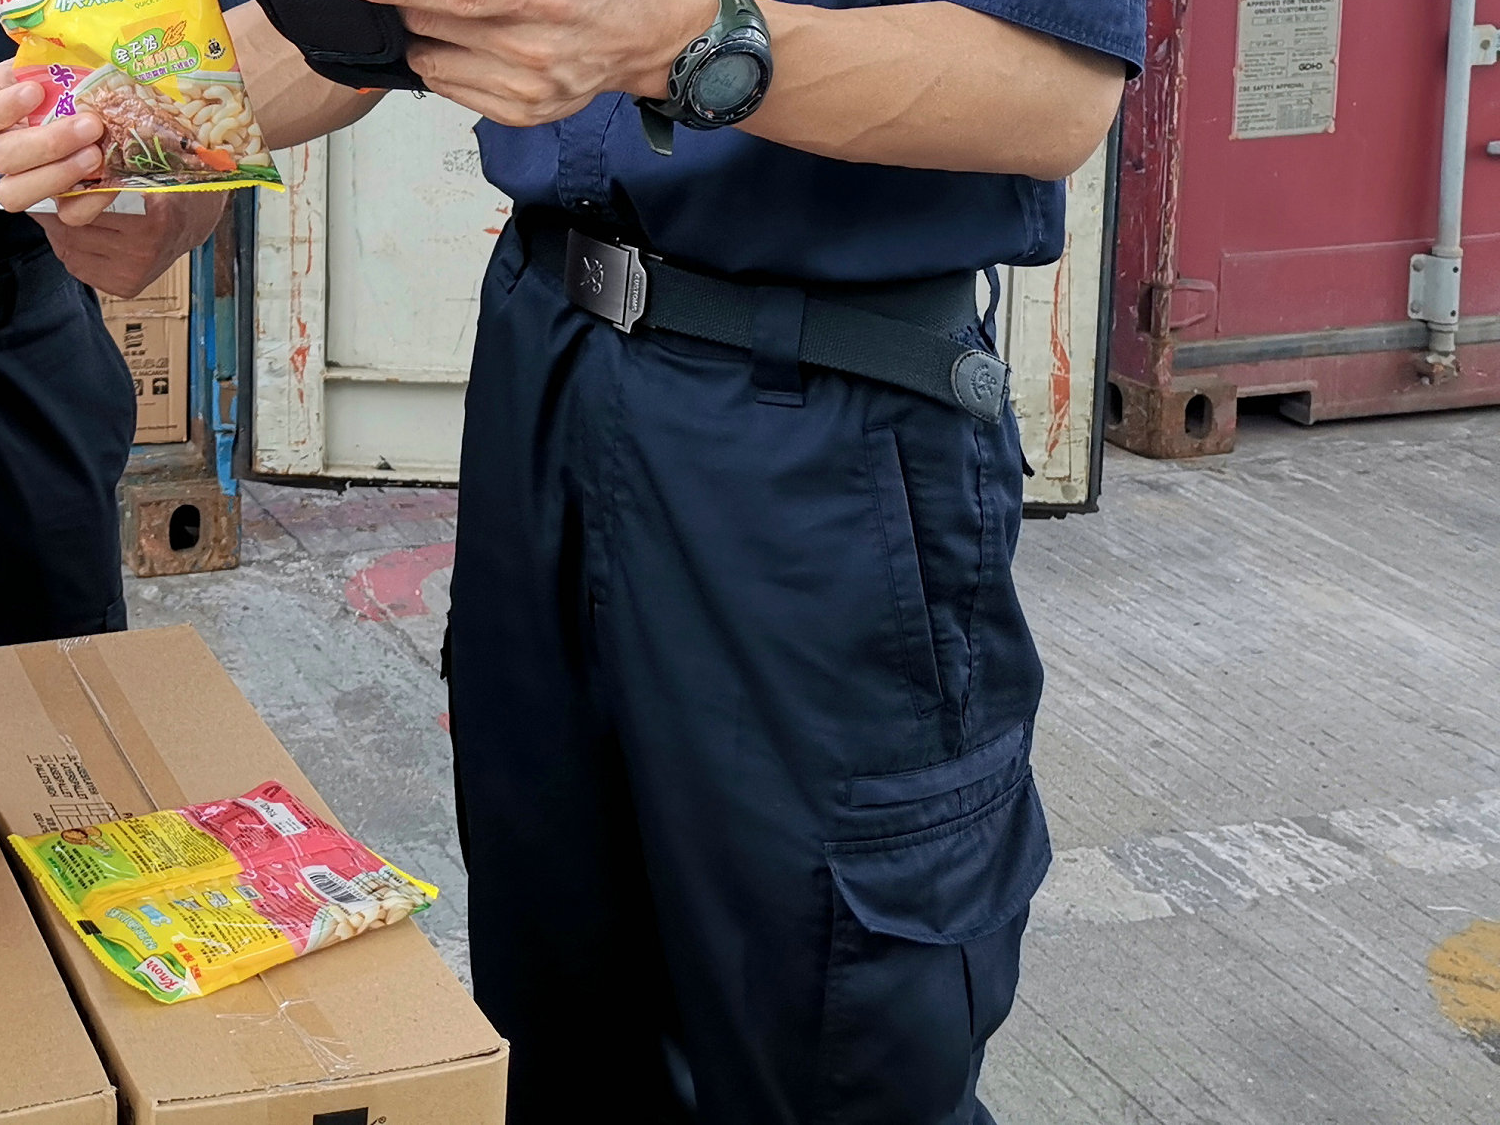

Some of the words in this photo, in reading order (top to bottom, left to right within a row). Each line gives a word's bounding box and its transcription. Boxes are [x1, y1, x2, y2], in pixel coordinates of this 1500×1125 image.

[134, 0, 155, 9] QUICK
[1247, 0, 1280, 8] APPROVED
[1254, 7, 1276, 15] UNDER
[632, 273, 641, 312] CUSTOMS
[146, 960, 180, 990] Knorr
